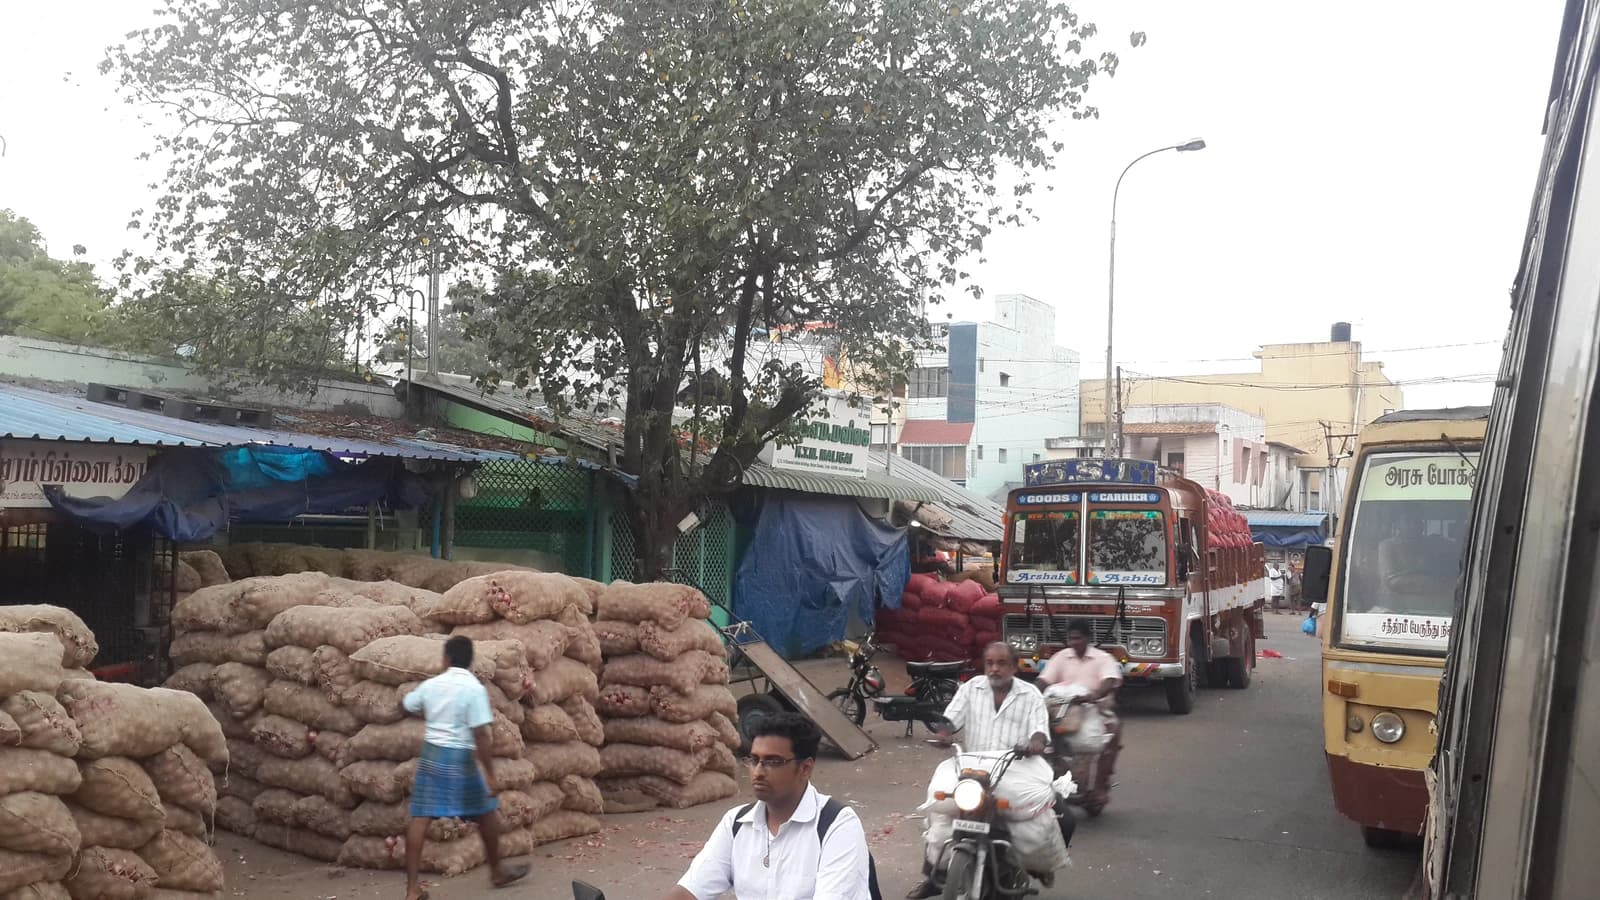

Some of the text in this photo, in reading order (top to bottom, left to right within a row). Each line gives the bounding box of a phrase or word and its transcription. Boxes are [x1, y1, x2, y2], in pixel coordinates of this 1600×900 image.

[819, 448, 853, 465] MALIGAI
[1385, 466, 1423, 488] அரசு
[1027, 493, 1148, 503] GOODS CARRIER
[1015, 572, 1066, 582] Arshak
[1104, 573, 1157, 585] Ashiq
